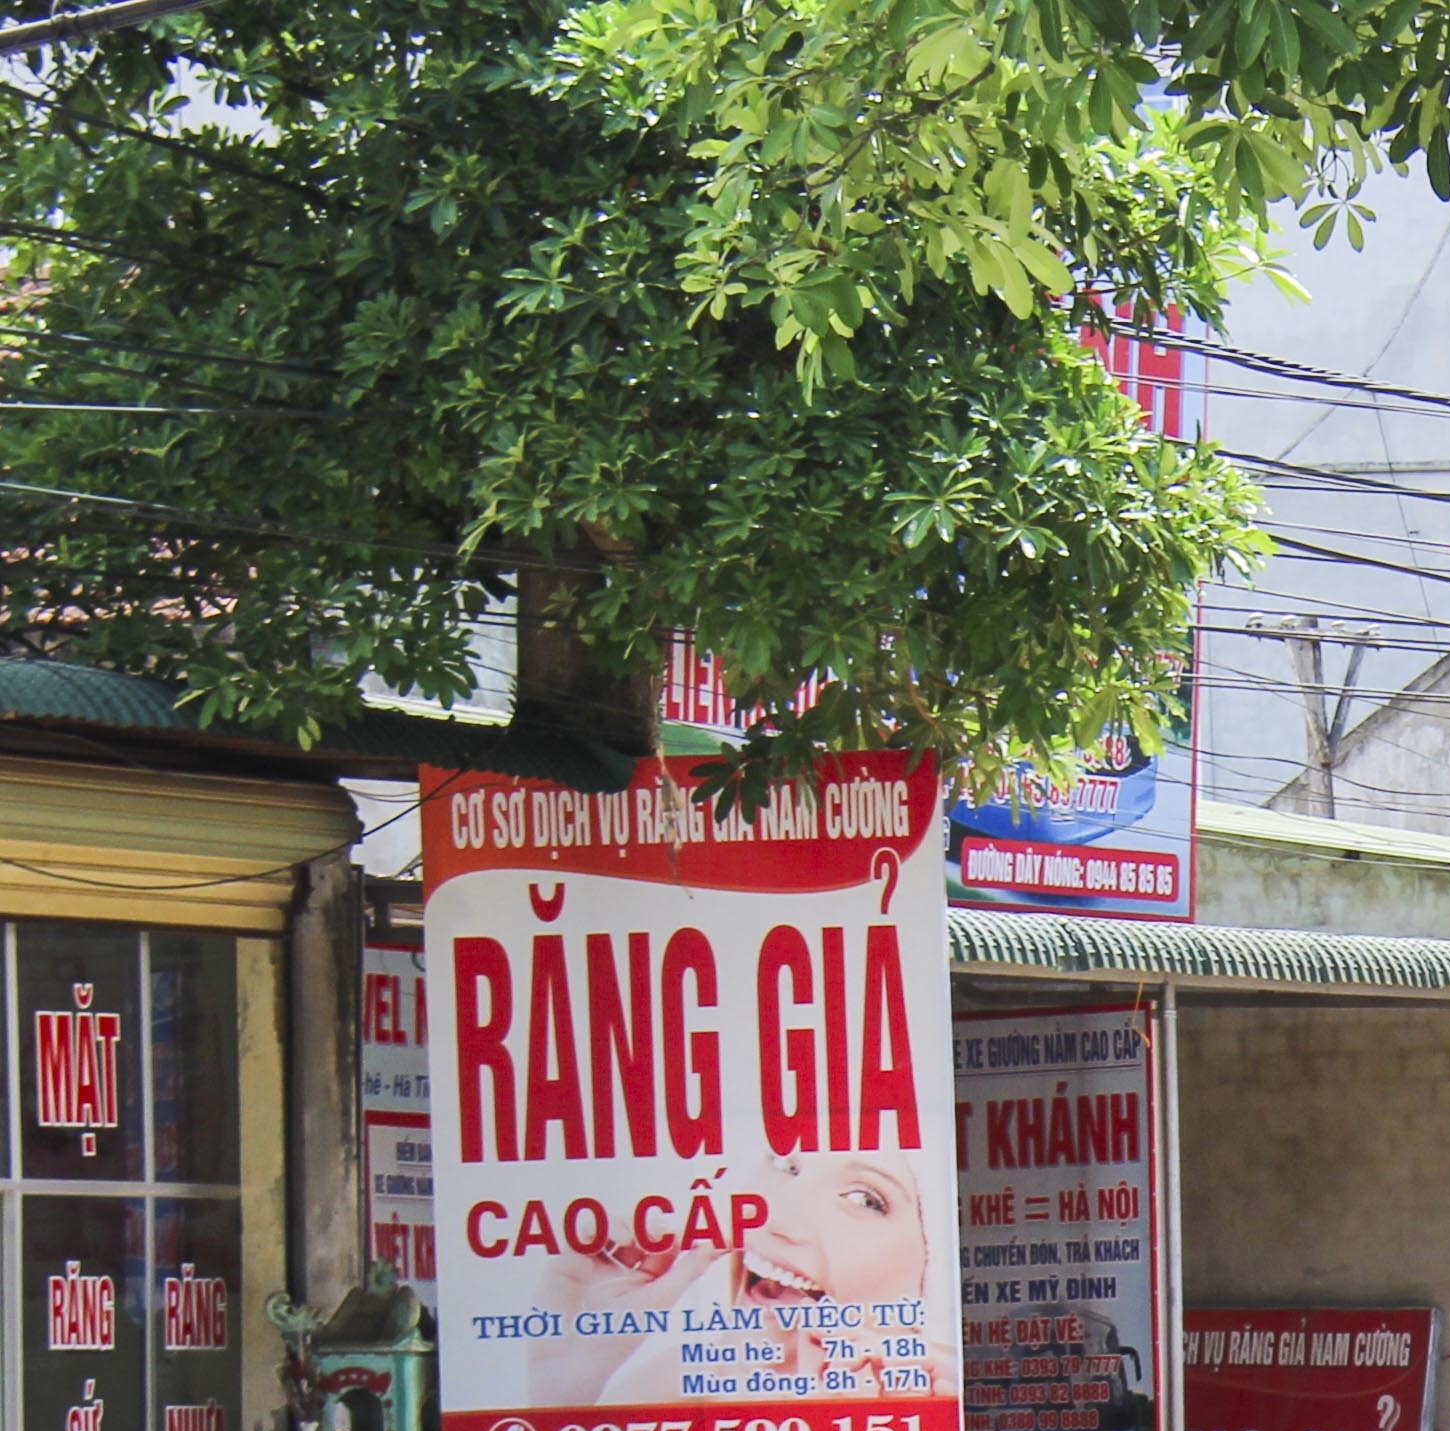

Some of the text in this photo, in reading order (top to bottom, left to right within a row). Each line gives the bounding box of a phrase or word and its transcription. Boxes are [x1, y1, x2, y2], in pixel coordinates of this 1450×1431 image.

[532, 790, 592, 860] DỊCH
[597, 790, 630, 858] VỤ
[825, 767, 910, 839] CƯỜNG
[452, 847, 922, 1164] RĂNG GIẢ
[34, 983, 120, 1155] MẶT
[1081, 1029, 1109, 1062] CAO
[986, 1081, 1140, 1170] KHÁNH
[465, 1197, 609, 1258] CAO
[633, 1167, 770, 1252] CẤP
[970, 1180, 1139, 1227] KHÊ HÀ NỘI
[48, 1260, 115, 1350] RĂNG
[164, 1262, 227, 1349] RĂNG
[472, 1307, 562, 1340] THỜI
[574, 1308, 671, 1337] GIAN
[682, 1301, 764, 1334] LÀM
[777, 1297, 864, 1334] VIỆC
[996, 1281, 1021, 1302] XE
[681, 1338, 928, 1364] Mùa hè: 7h 18h
[1311, 1332, 1349, 1366] NAM
[682, 1367, 929, 1399] Mùa đông: 8h 17h
